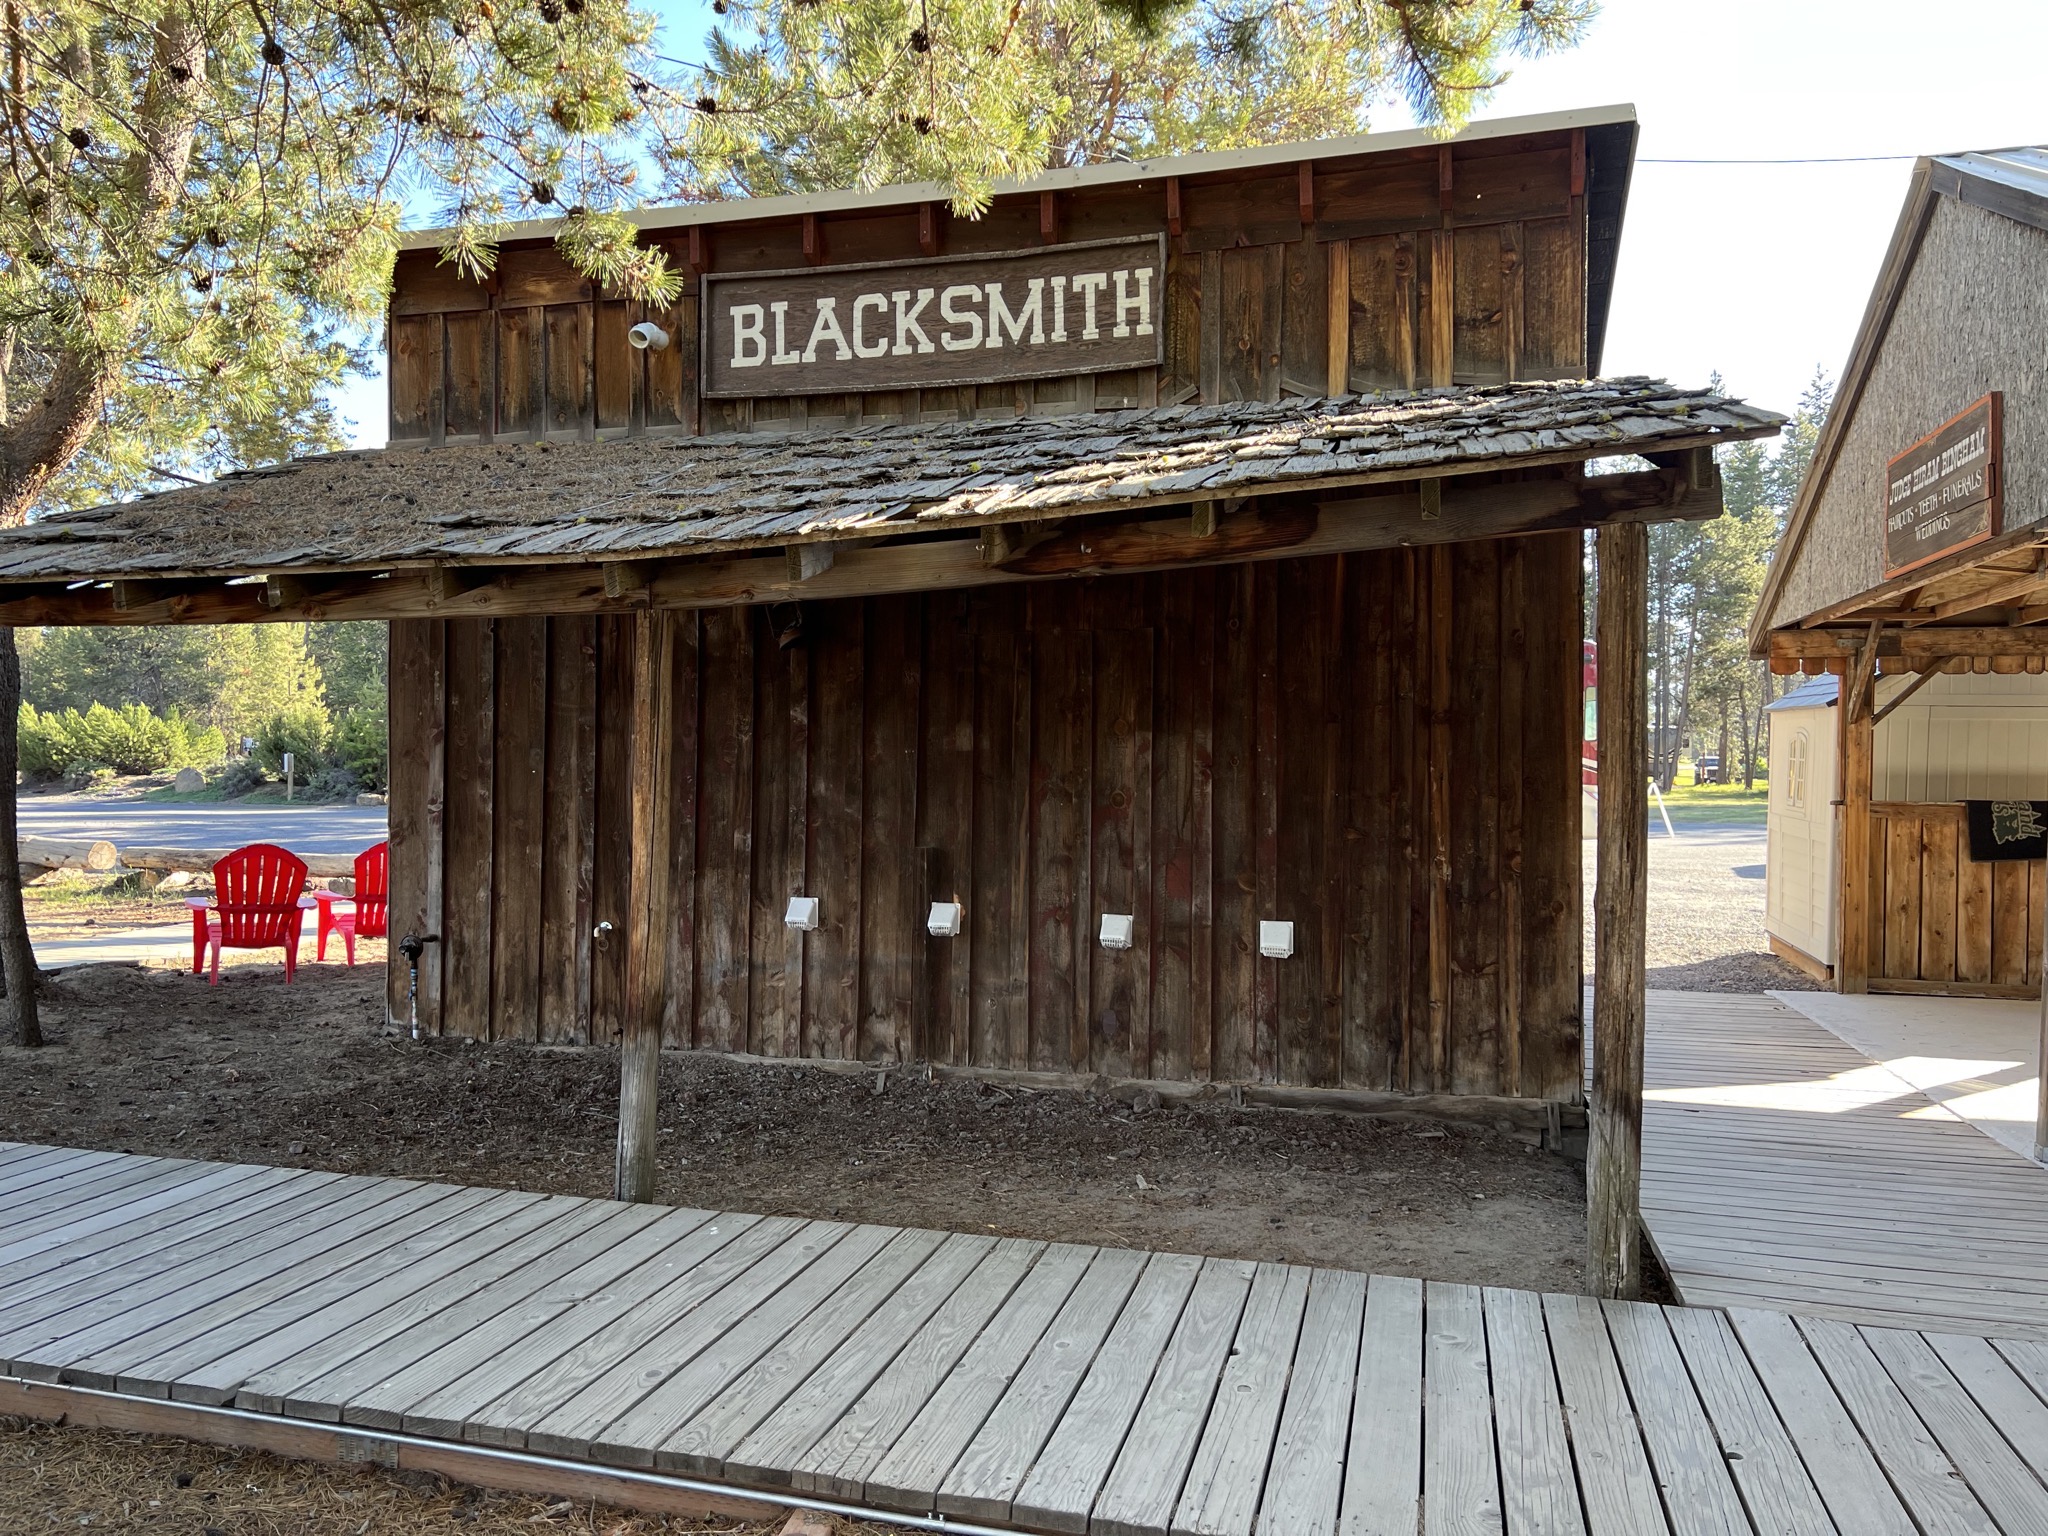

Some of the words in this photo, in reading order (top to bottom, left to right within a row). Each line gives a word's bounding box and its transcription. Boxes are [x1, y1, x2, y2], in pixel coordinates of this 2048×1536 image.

[730, 267, 1154, 368] BLACKSMITH
[1888, 506, 1914, 533] HAIRCUTS
[1918, 492, 1938, 517] TEETH
[1942, 469, 1982, 505] FUNERALS
[1889, 473, 1912, 506] JUDGE
[1912, 455, 1940, 492] HIRAM
[1941, 426, 1986, 477] BINGHAM
[1914, 511, 1951, 542] WEDDINGS
